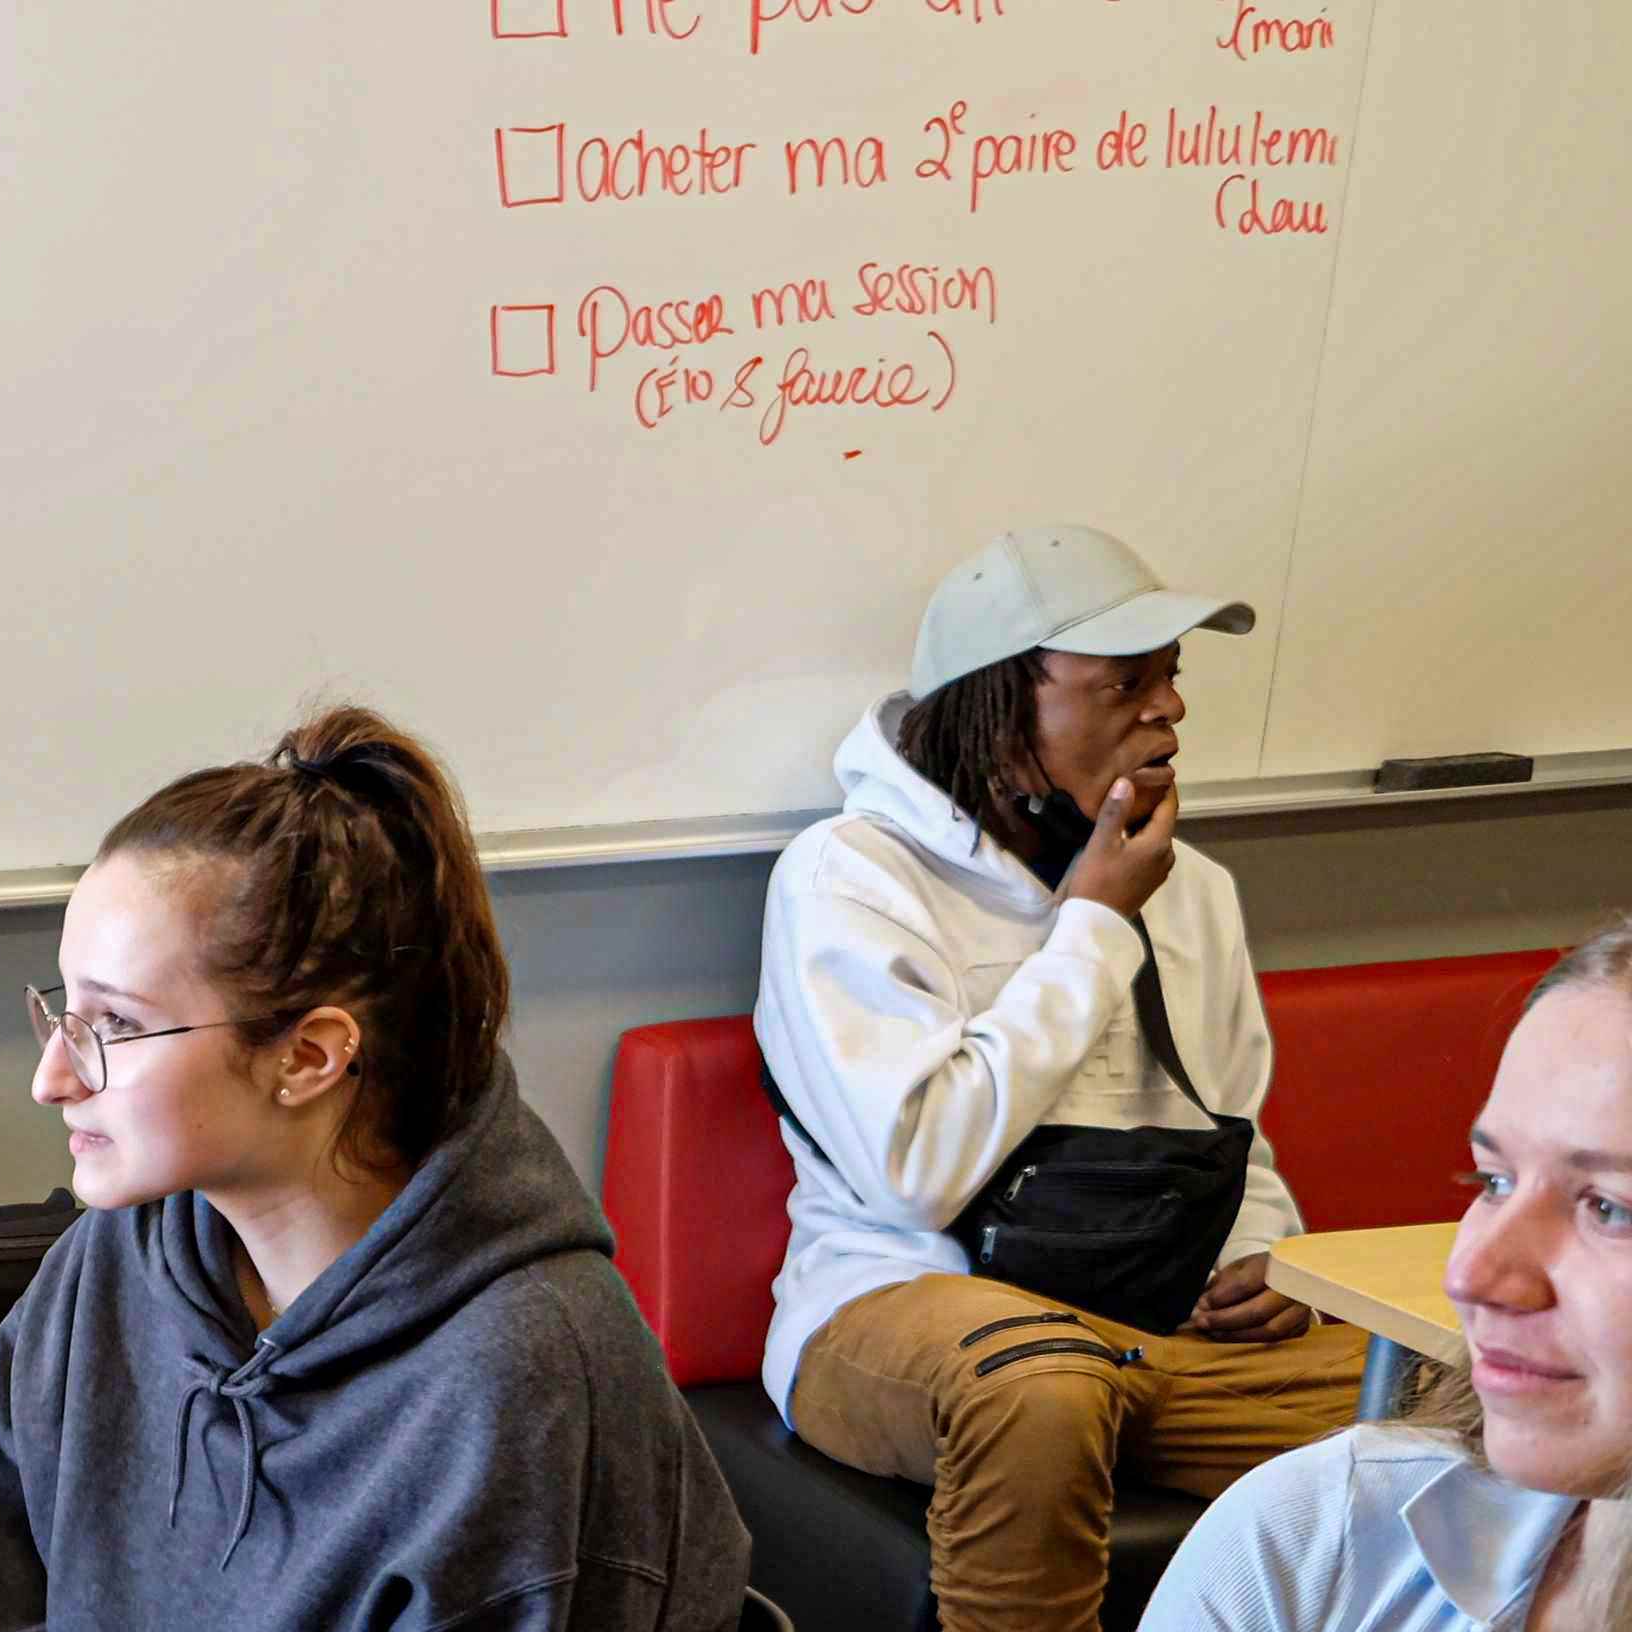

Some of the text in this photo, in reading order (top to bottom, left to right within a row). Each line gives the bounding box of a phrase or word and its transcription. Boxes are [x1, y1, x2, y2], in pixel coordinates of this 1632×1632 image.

[576, 126, 758, 202] acheter
[784, 129, 889, 197] ma
[970, 113, 1078, 214] paire
[1096, 108, 1149, 171] de
[752, 278, 836, 329] ma
